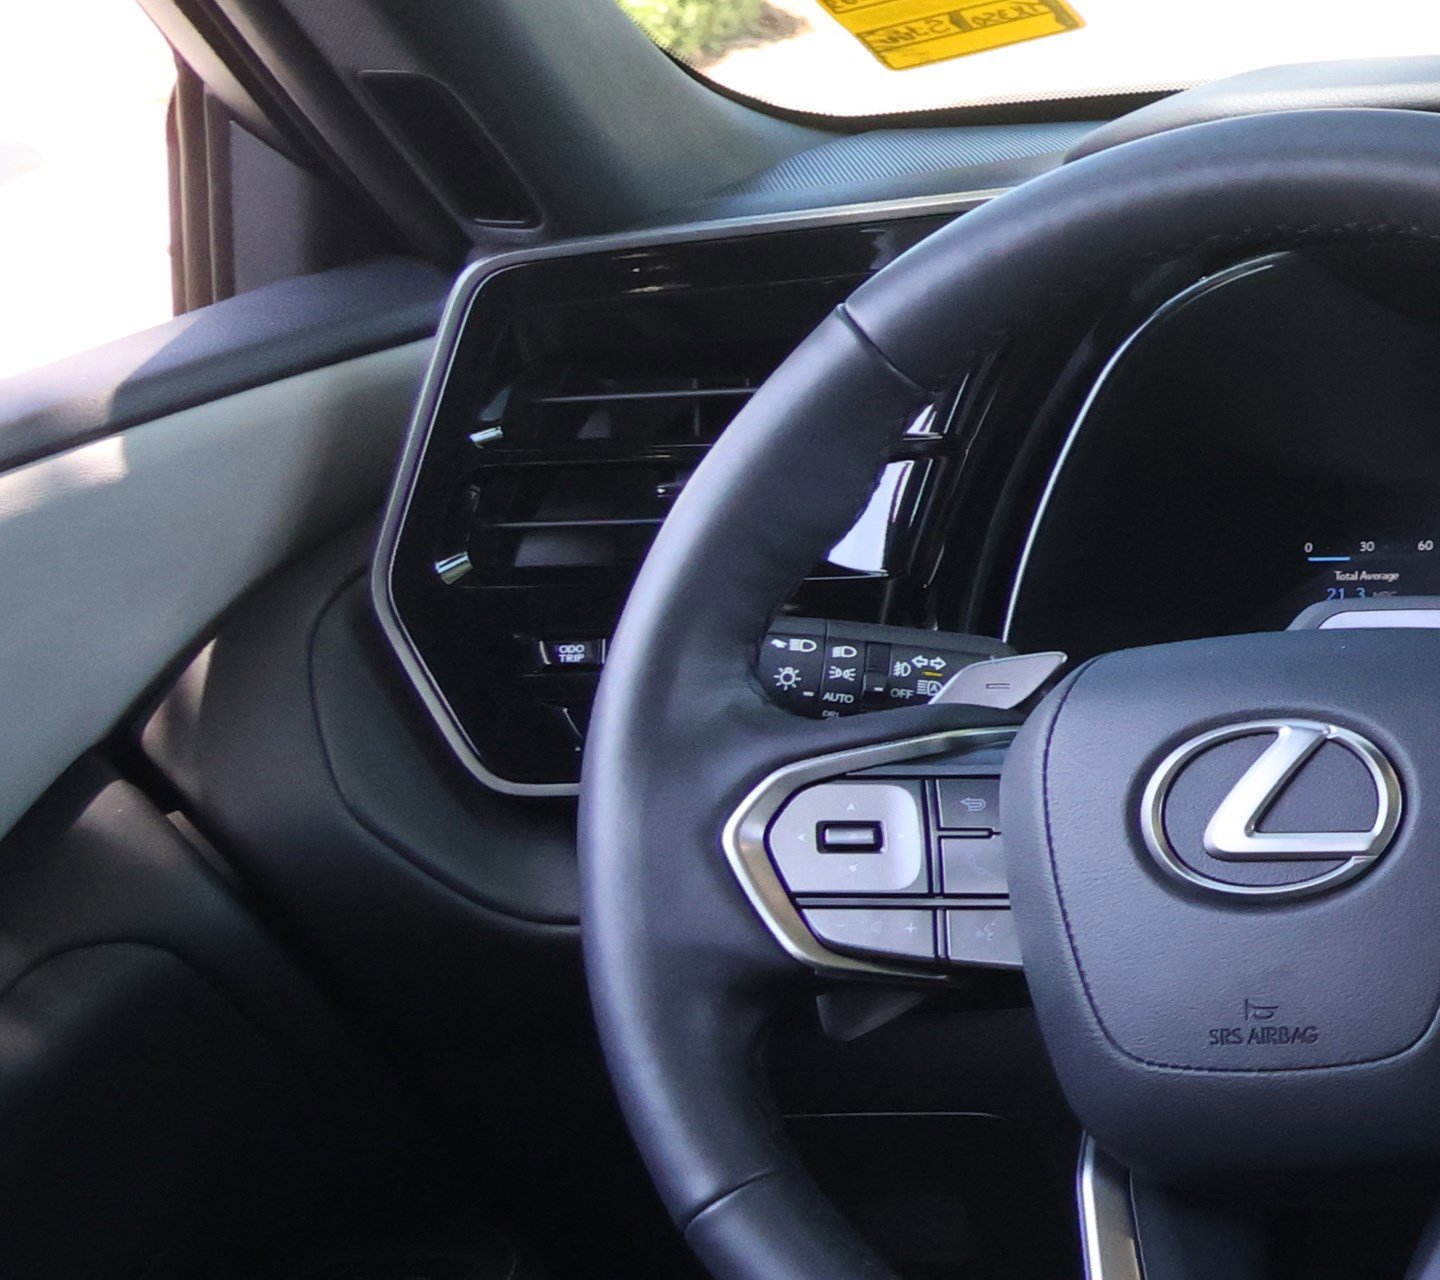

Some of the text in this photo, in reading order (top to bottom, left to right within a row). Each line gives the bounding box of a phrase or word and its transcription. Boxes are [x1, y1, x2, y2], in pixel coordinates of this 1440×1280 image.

[1304, 540, 1434, 553] 0 30 60
[1334, 570, 1400, 582] Total Average
[558, 644, 585, 653] ODO
[558, 654, 585, 663] TRIP
[822, 692, 854, 704] AUTO
[890, 689, 915, 699] OFF
[1209, 1025, 1318, 1046] SRS AIRBAG
